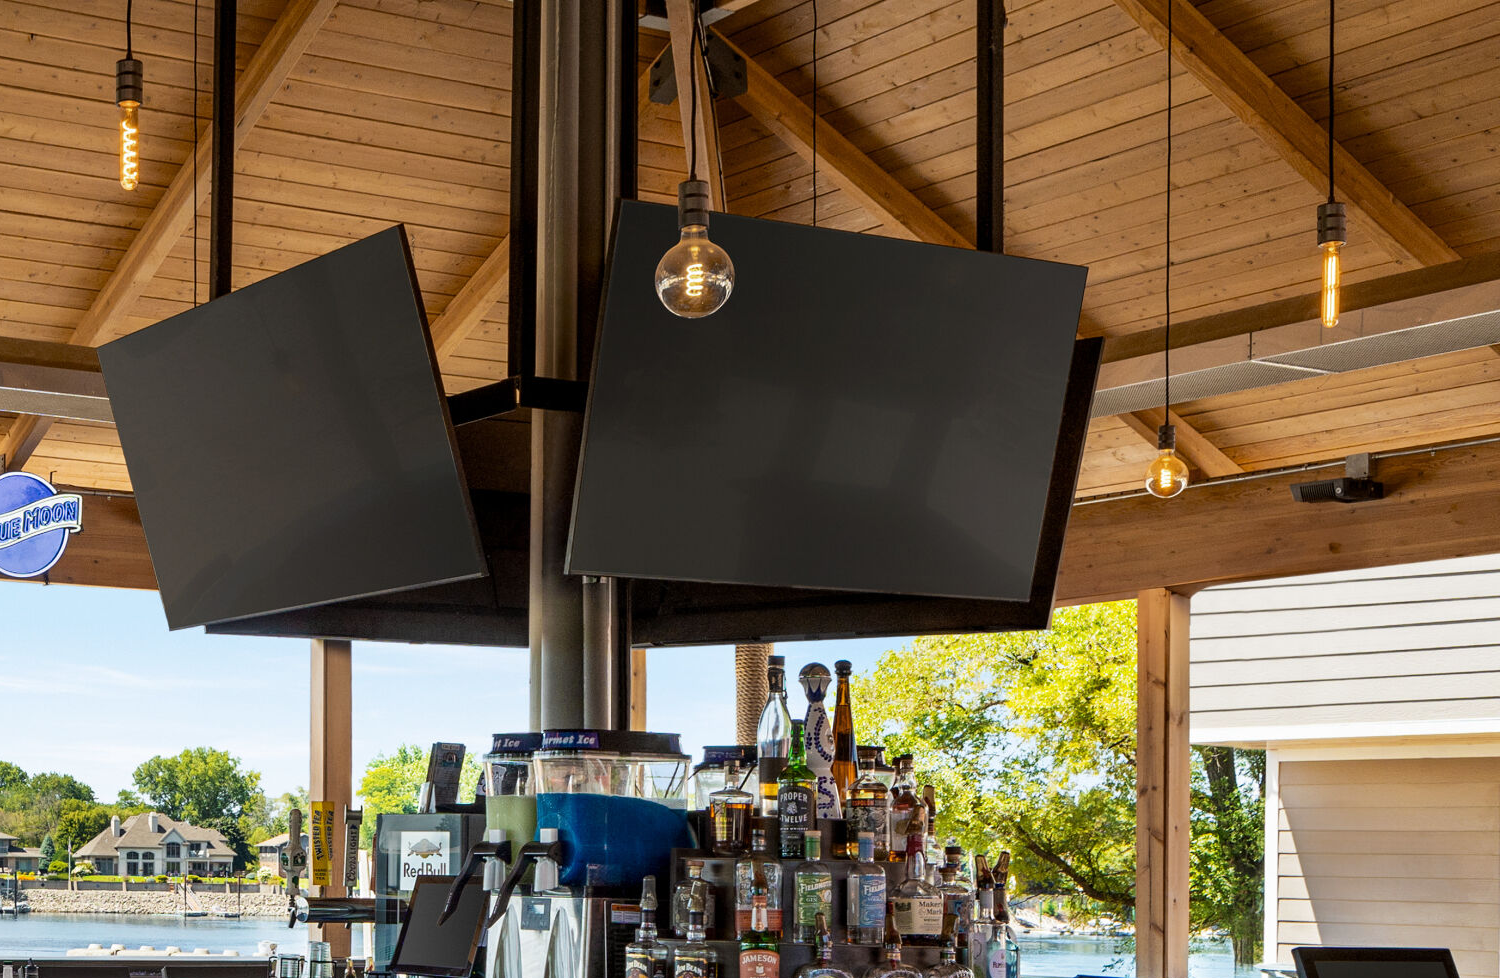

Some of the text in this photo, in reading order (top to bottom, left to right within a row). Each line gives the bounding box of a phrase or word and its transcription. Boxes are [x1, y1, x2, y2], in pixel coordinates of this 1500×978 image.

[503, 738, 521, 748] Ice
[576, 734, 596, 745] Ice
[780, 792, 808, 802] PROPER
[780, 814, 808, 823] TWELVE
[312, 810, 324, 861] TWISTED TEA
[403, 862, 447, 878] Red Bull
[742, 954, 777, 965] JAMESON
